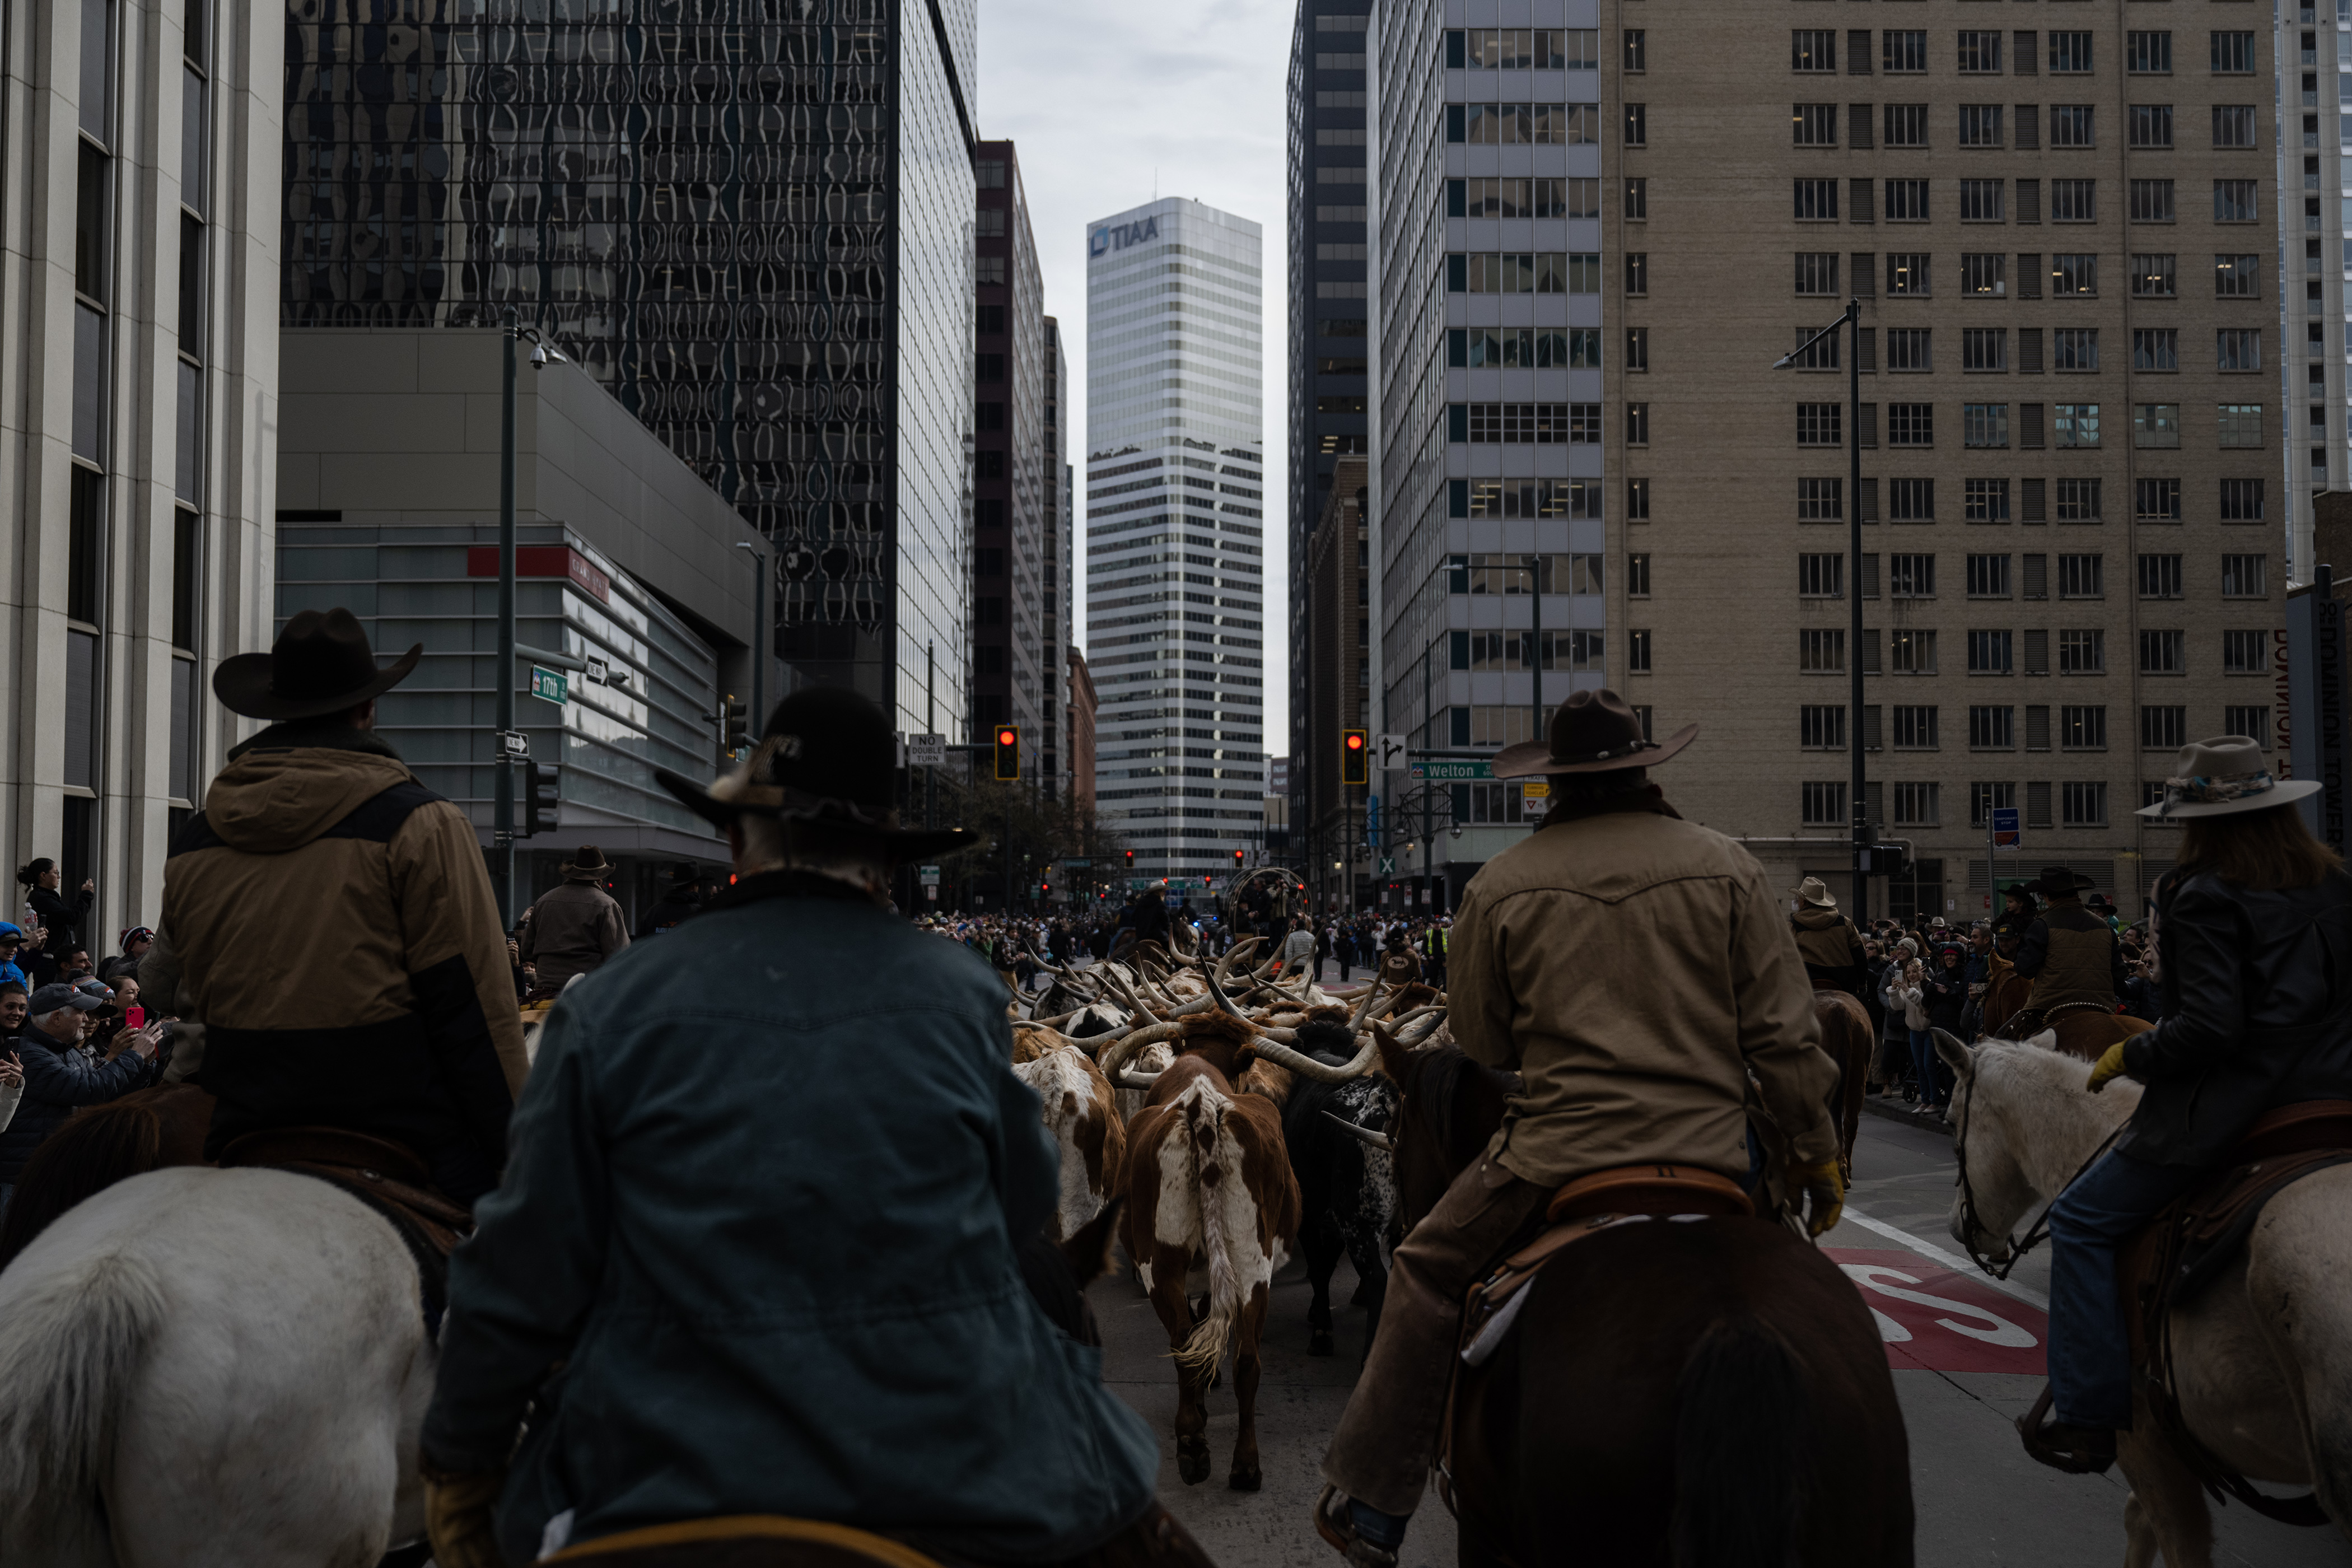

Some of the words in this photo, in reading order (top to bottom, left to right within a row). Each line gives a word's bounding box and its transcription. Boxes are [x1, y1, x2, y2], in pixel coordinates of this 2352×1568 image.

[1111, 216, 1159, 250] TIAA
[543, 675, 558, 697] 17th
[2320, 627, 2341, 749] DOMINION
[919, 736, 935, 745] NO
[1429, 764, 1474, 777] Welton
